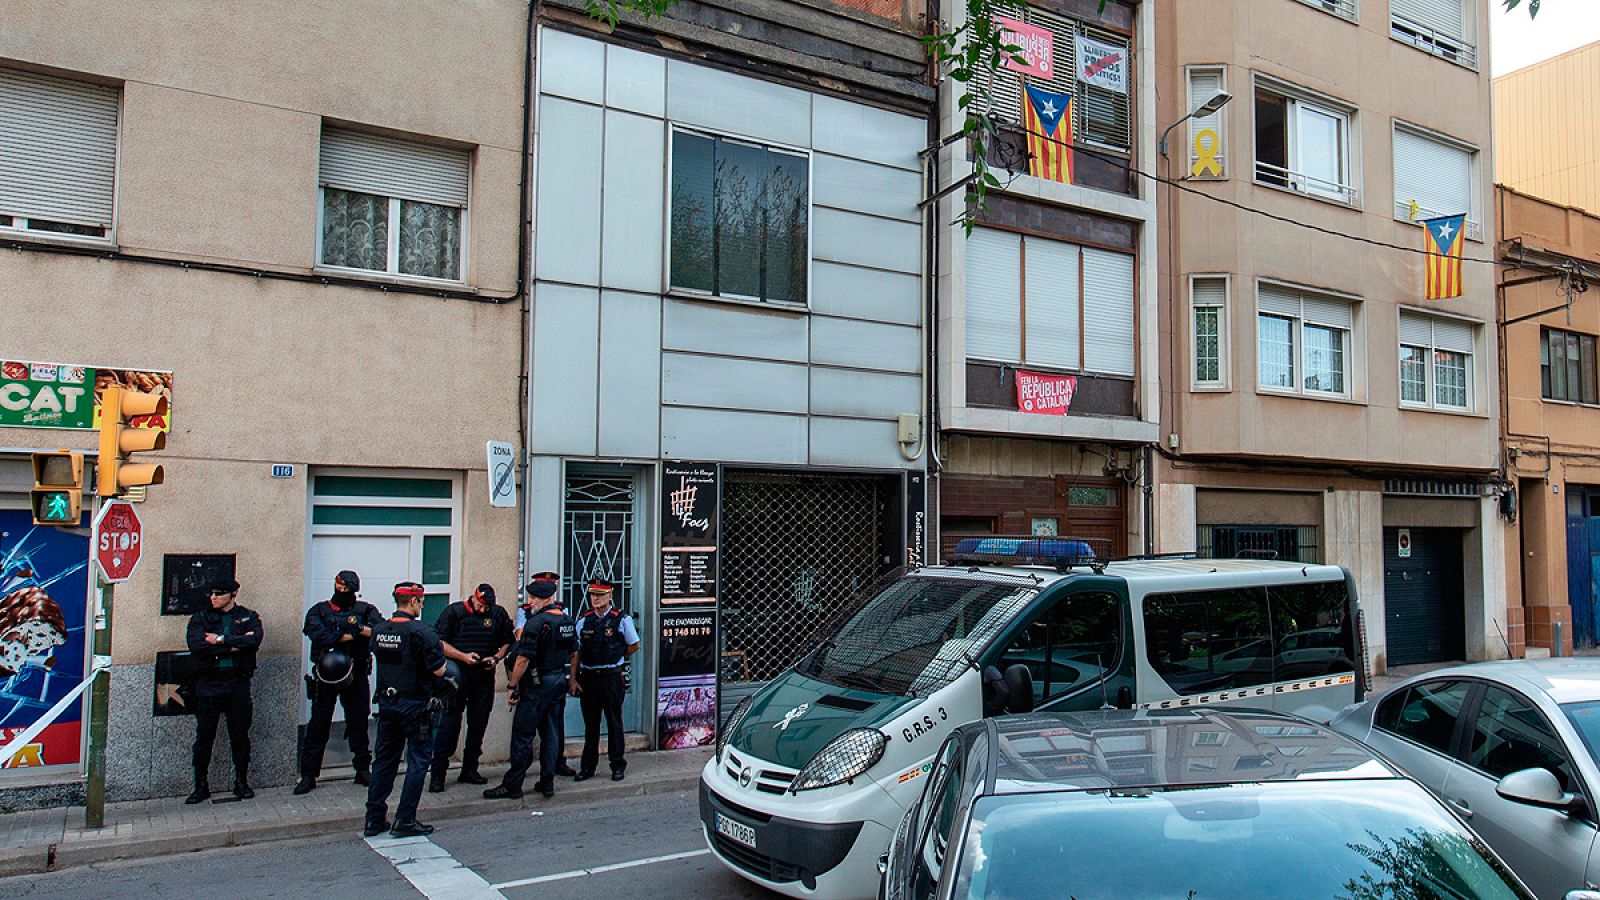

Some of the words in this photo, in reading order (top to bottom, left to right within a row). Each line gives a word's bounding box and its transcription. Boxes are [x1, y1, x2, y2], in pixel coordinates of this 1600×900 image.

[1022, 379, 1073, 400] REPÚBLICA
[493, 445, 511, 456] ZONA
[681, 511, 709, 532] Focs
[99, 531, 140, 551] STOP
[902, 715, 937, 743] G.R.S.
[938, 706, 948, 721] 3
